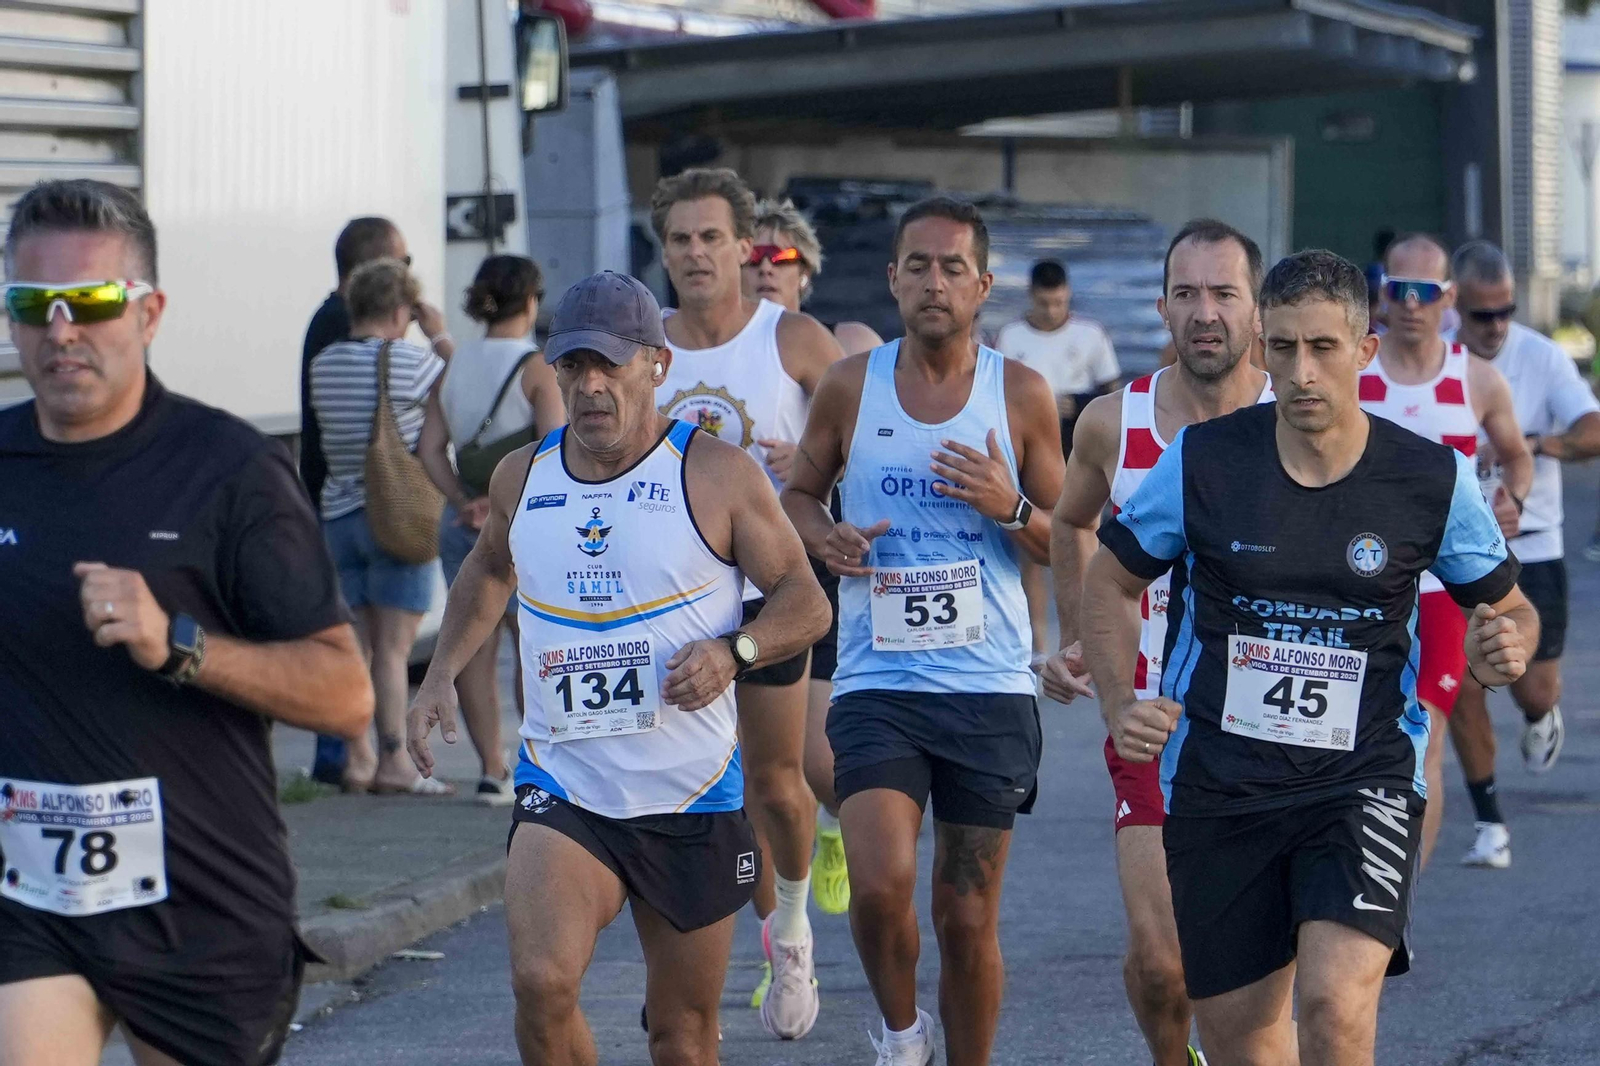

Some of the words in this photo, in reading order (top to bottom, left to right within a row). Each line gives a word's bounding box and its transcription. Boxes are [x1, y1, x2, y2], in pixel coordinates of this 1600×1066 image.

[638, 501, 676, 513] seguros
[1240, 545, 1276, 553] OTTOBOSLEY
[1351, 533, 1386, 550] CONDADO
[566, 571, 622, 579] ATLETISMO
[875, 571, 902, 584] 10KMS
[904, 569, 948, 585] ALFONSO
[951, 565, 977, 580] MORO
[1355, 567, 1380, 577] TRAIL
[567, 581, 624, 594] SAMIL
[921, 584, 953, 592] SETEMBRO
[904, 592, 958, 627] 53
[567, 643, 615, 662] ALFONSO
[617, 640, 650, 657] MORO
[1235, 641, 1270, 660] 10KMS
[1273, 647, 1326, 667] ALFONSO
[1328, 654, 1362, 671] MORO
[585, 661, 620, 670] SETEMBRO
[632, 657, 649, 665] 2026
[1291, 667, 1328, 677] SETEMBRO
[1340, 672, 1357, 680] 2026
[555, 668, 644, 713] 134
[1263, 676, 1328, 719] 45
[42, 793, 104, 813] ALFONSO
[53, 815, 65, 823] DE
[67, 816, 113, 826] SETEMBRO
[116, 815, 128, 823] DE
[41, 828, 119, 877] 78
